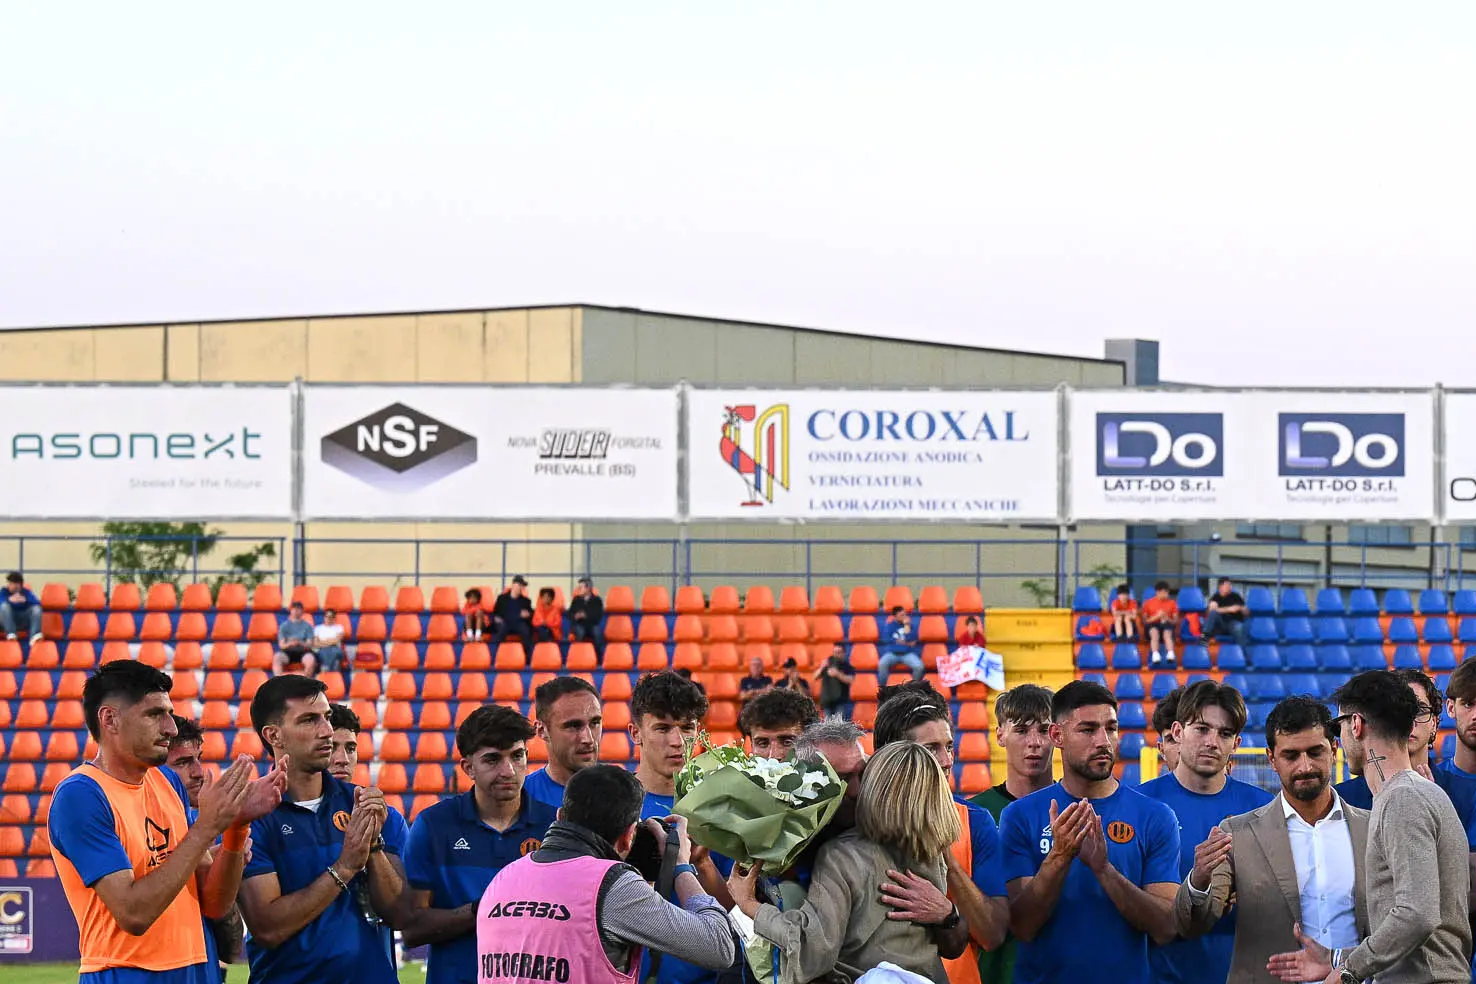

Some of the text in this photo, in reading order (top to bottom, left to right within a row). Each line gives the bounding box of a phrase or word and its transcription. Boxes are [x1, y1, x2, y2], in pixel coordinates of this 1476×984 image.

[806, 409, 1030, 441] COROXAL
[357, 415, 440, 458] NSF
[808, 452, 983, 463] OSSIDAZIONE ANODICA
[534, 463, 606, 475] PREVALLE
[808, 475, 923, 487] VERNICIATURA
[1104, 479, 1216, 491] LATT-DO S.r.l.
[1286, 479, 1397, 491] LATT-DO S.r.l.
[808, 499, 1020, 511] LAVORAZIONI MECCANICHE
[1040, 838, 1055, 854] 9
[488, 901, 571, 921] ACERBIS
[482, 953, 570, 983] FOTOGRAFO
